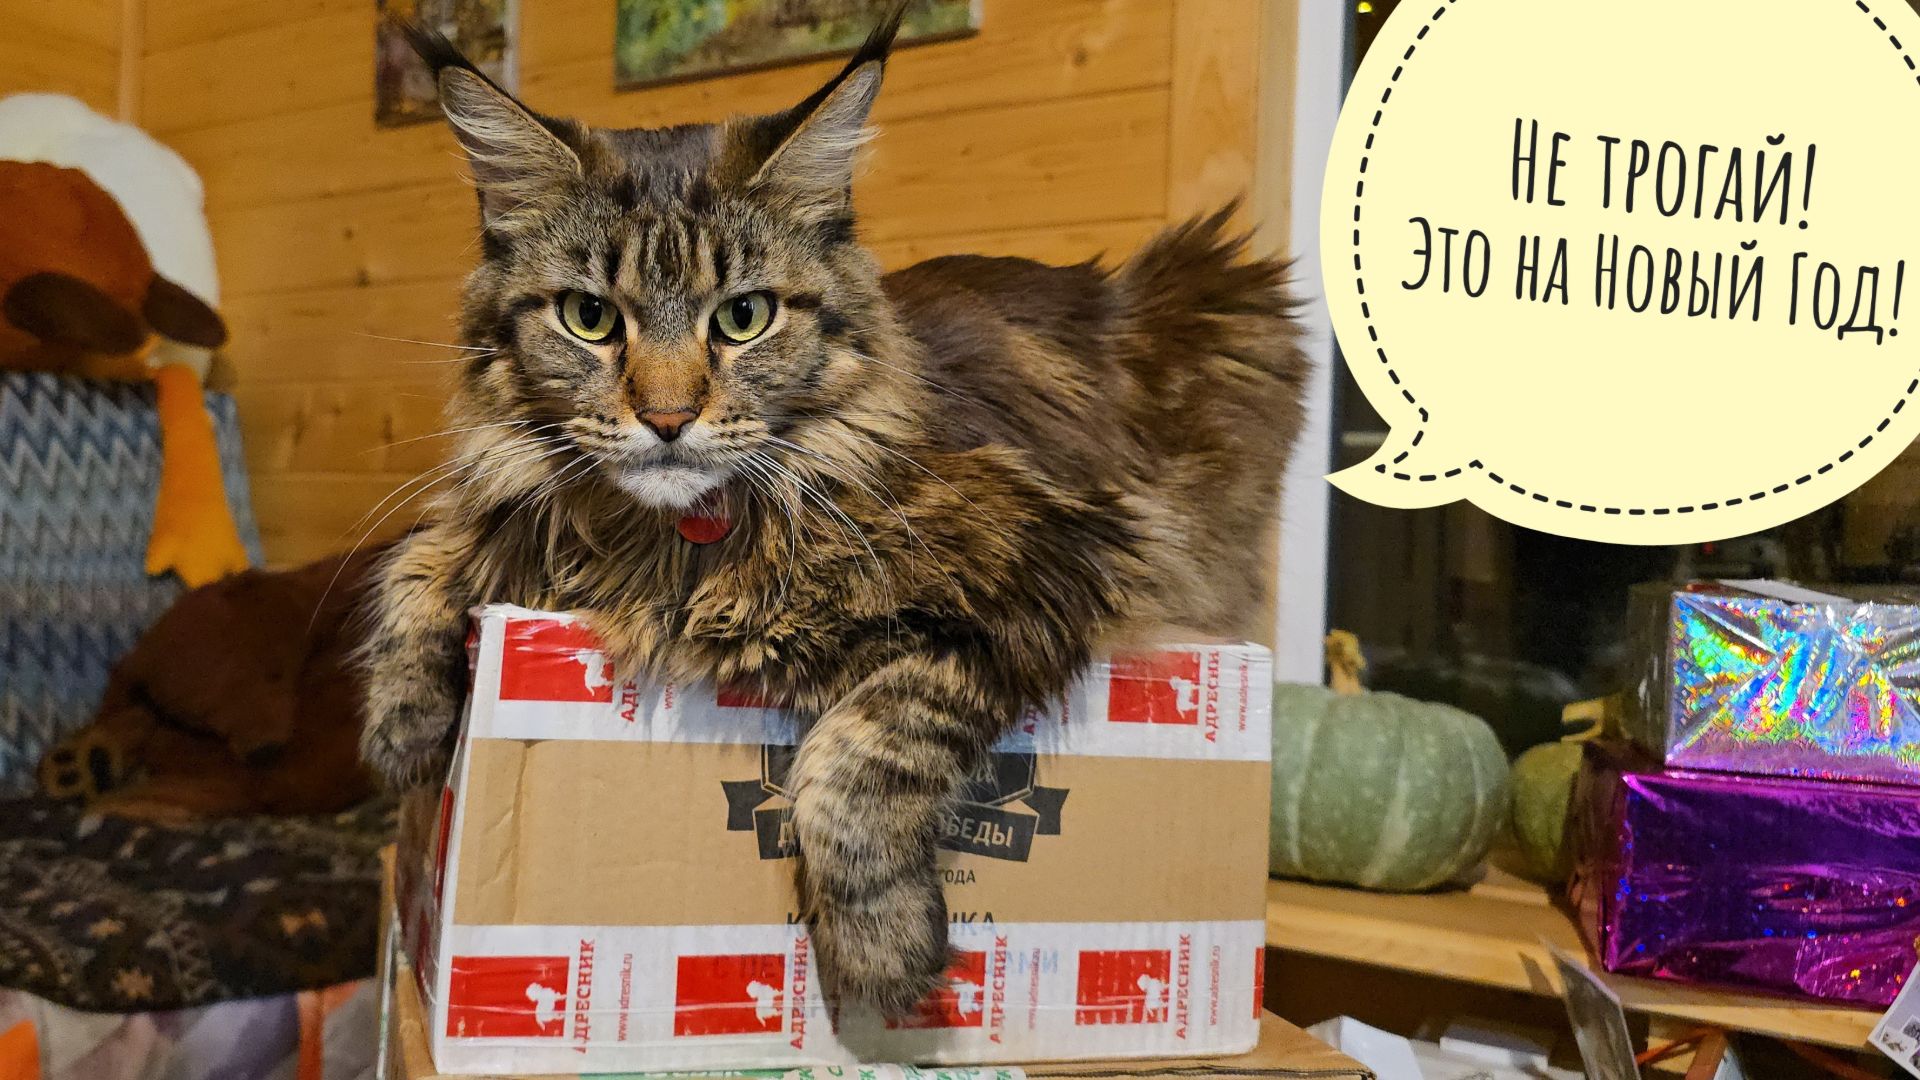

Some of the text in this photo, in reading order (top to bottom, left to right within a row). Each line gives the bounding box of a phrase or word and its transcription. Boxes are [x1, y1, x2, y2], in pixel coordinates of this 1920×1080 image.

[1239, 652, 1249, 732] www.adresnik.
[790, 935, 809, 1050] АДРЕСНИК
[989, 934, 1008, 1044] АДРЕСНИК
[1176, 933, 1191, 1040] АДРЕСНИК
